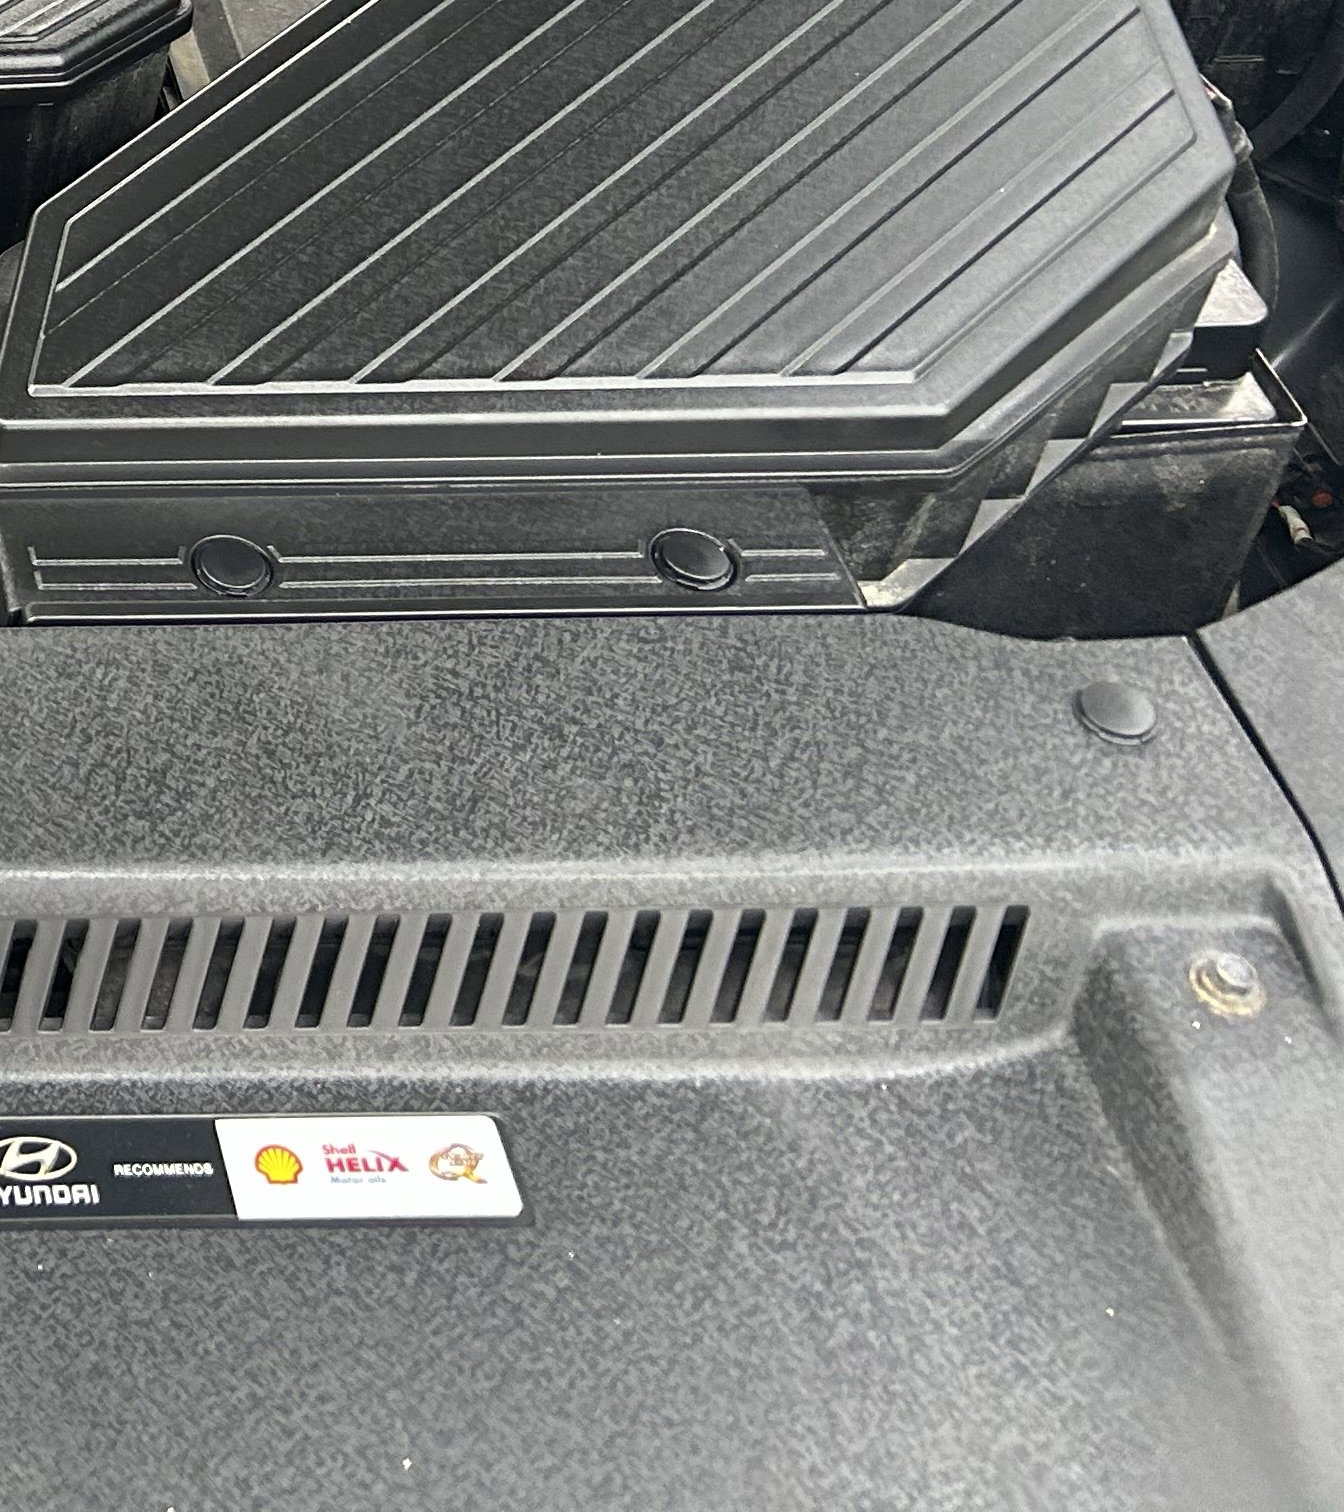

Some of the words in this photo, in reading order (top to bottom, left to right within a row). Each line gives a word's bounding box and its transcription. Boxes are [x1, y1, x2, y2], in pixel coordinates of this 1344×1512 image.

[321, 1143, 357, 1155] Shell
[113, 1161, 215, 1177] RECOMMENDS
[325, 1153, 410, 1173] HELIX
